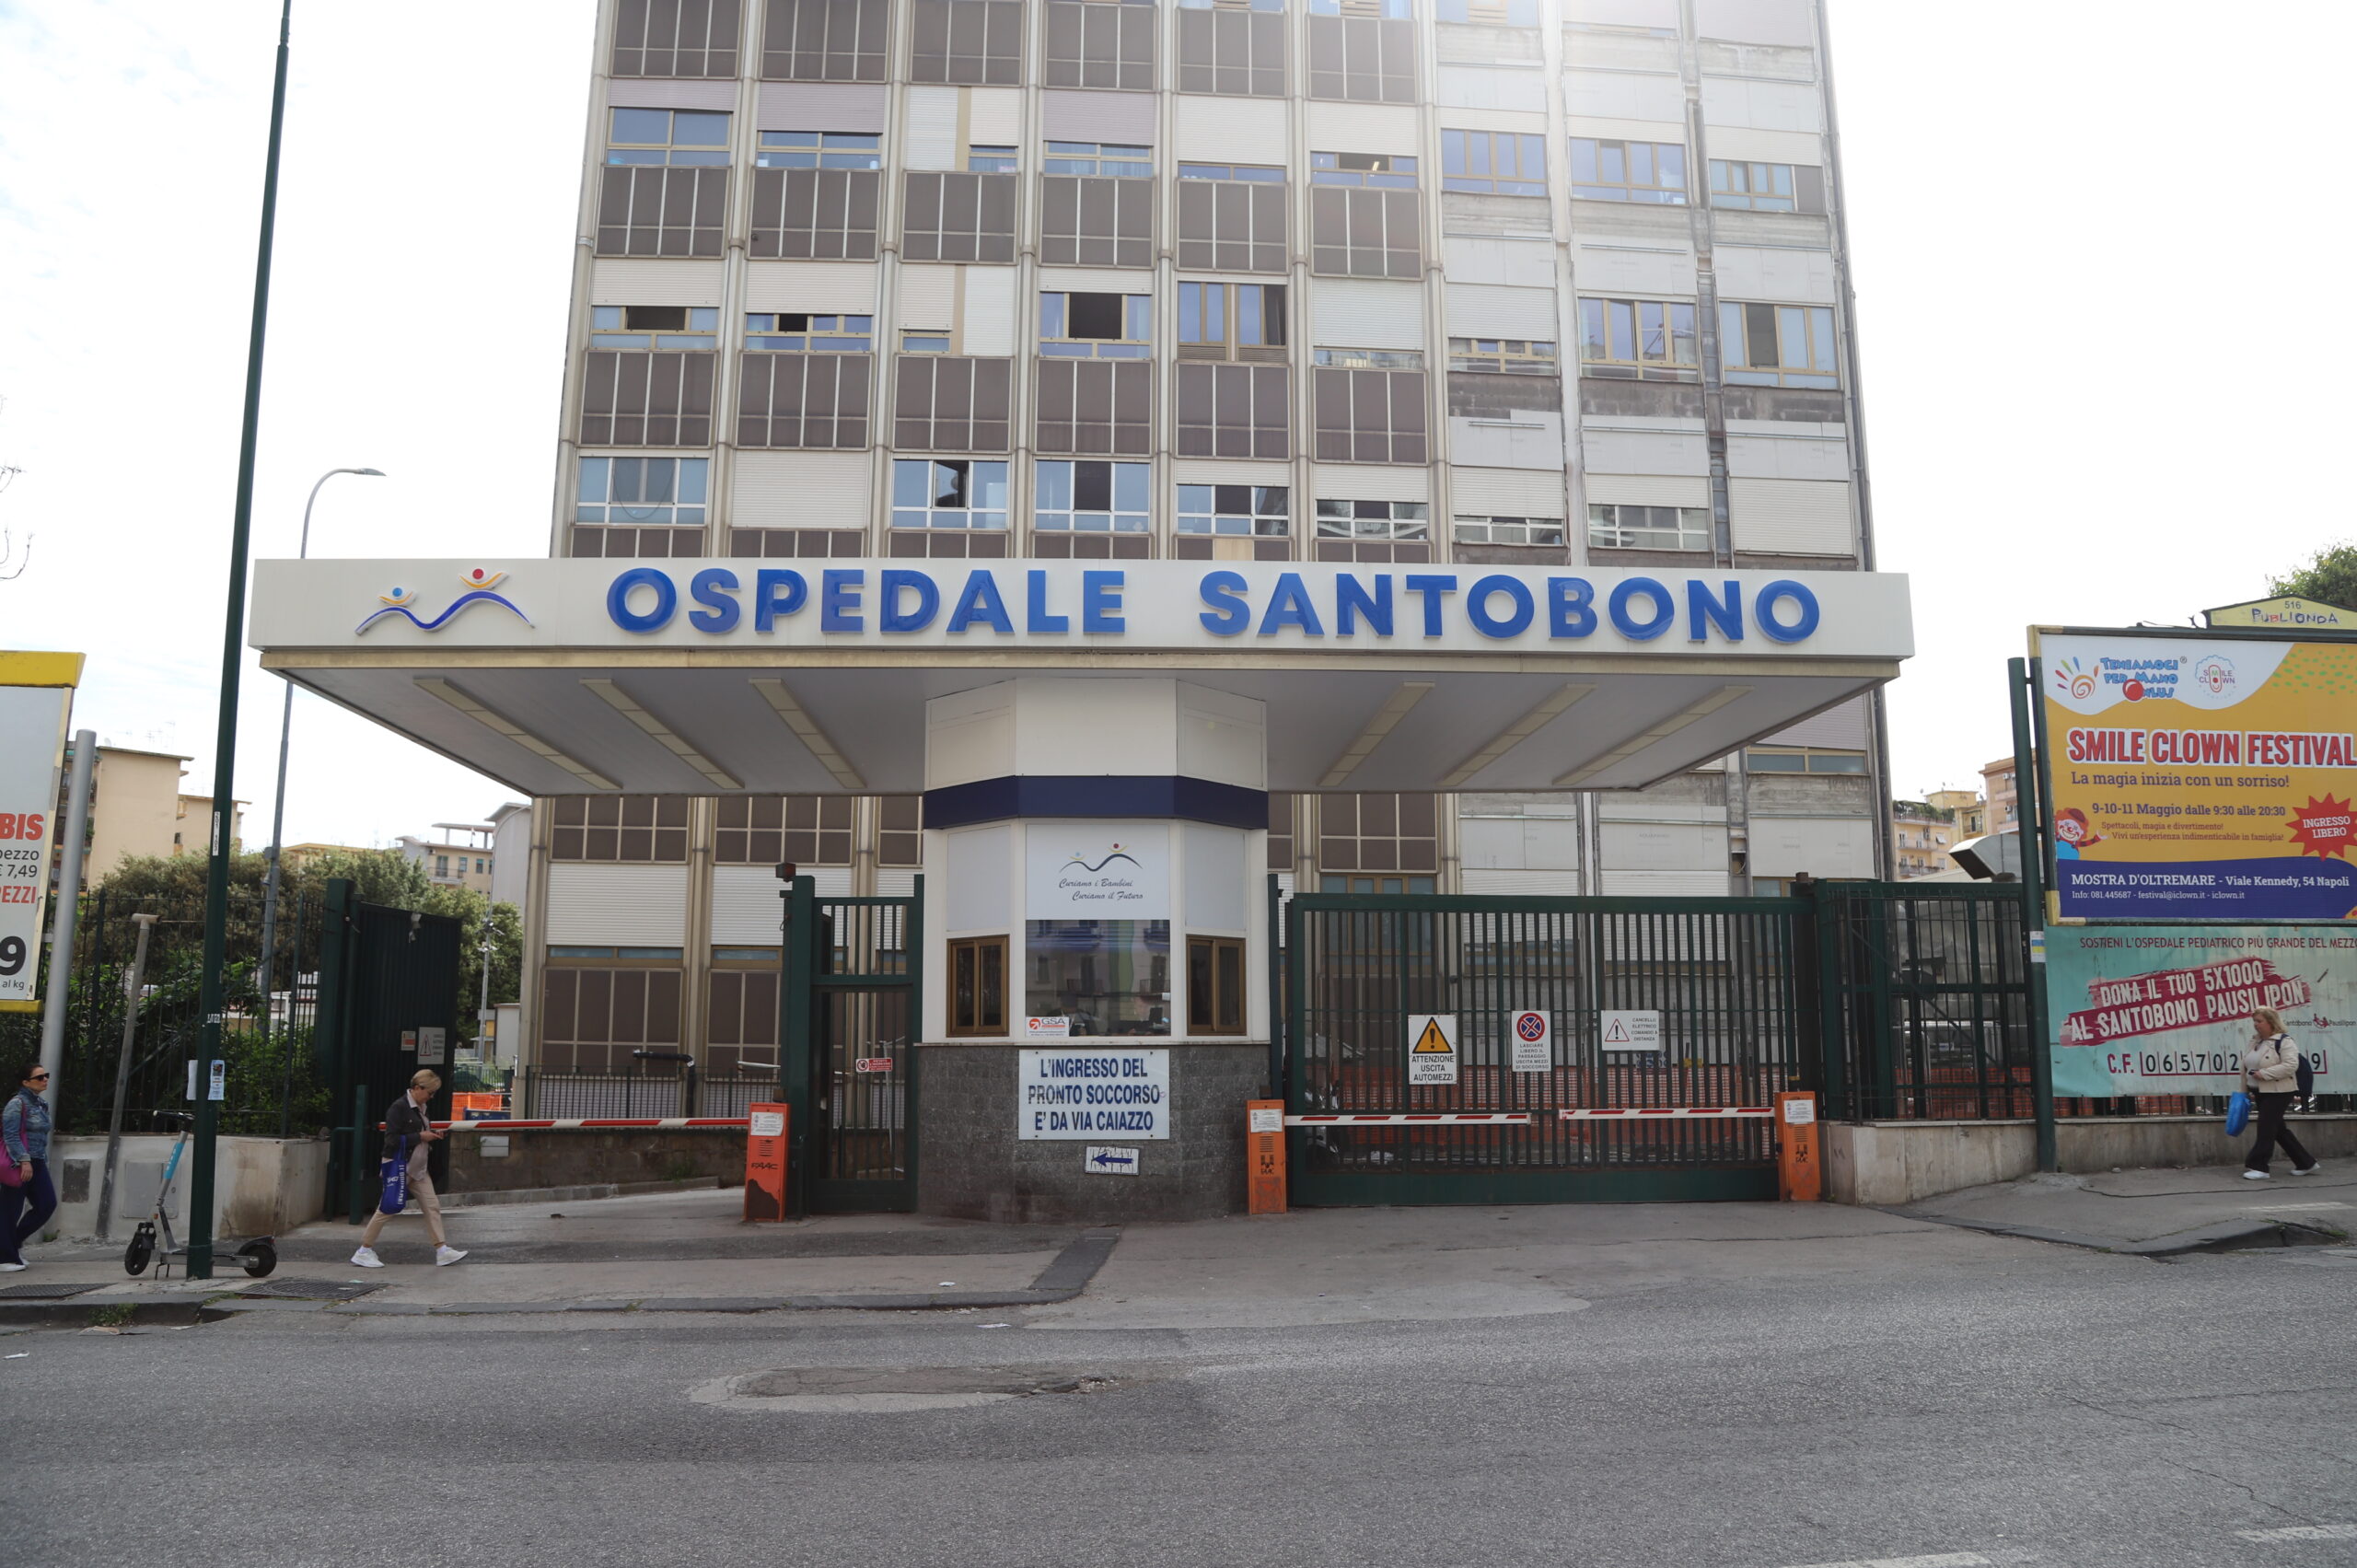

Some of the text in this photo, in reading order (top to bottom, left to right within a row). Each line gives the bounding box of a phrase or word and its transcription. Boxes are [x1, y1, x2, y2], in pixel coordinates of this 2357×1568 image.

[608, 567, 1820, 645] OSPEDALE SANTOBONO
[2284, 601, 2302, 610] 516
[2068, 729, 2357, 766] SMILE CLOWN FESTIVAL
[2071, 772, 2290, 788] La magia inizia con un sorriso!
[2092, 803, 2286, 818] 9-10-11 Maggio dalle 9:30 alle 20:30
[2101, 821, 2141, 830] Spettacoli,
[2142, 822, 2165, 831] magia
[2173, 822, 2223, 830] divertimento!
[2303, 816, 2351, 829] INGRESSO
[2182, 832, 2240, 841] indimenticabile
[2312, 827, 2347, 839] LIBERO
[7, 864, 38, 879] 7,49
[1059, 877, 1092, 889] Curiamo
[1100, 877, 1133, 887] Bambini
[2072, 874, 2126, 885] MOSTRA
[2129, 874, 2216, 886] D'OLTREMARE
[2224, 876, 2252, 886] Viale
[2254, 877, 2302, 889] Kennedy,
[2303, 877, 2315, 886] 54
[2316, 877, 2350, 889] Napoli
[0, 885, 37, 904] EZZI
[1072, 890, 1144, 901] Curiamo il Futuro
[2072, 890, 2089, 899] Info:
[2138, 890, 2206, 900] festival@iclown.it
[2212, 891, 2245, 900] iclown.it
[2080, 936, 2123, 948] SOSTIENI
[2126, 937, 2185, 948] L'OSPEDALE
[2188, 937, 2245, 948] PEDIATRICO
[2247, 935, 2263, 948] PIÙ
[2266, 937, 2305, 948] GRANDE
[2308, 937, 2328, 948] DEL
[2, 980, 25, 991] al kg
[2100, 960, 2264, 1007] DONA IL TUO 5X1000
[2071, 1016, 2094, 1042] AL
[2096, 997, 2200, 1038] SANTOBONO
[1411, 1055, 1455, 1063] ATTENZIONE
[2107, 1053, 2135, 1074] C.F.
[1040, 1058, 1148, 1078] L'INGRESSO DEL
[1028, 1085, 1160, 1105] PRONTO SOCCORSO
[1035, 1110, 1154, 1132] E' DA VIA CAIAZZO
